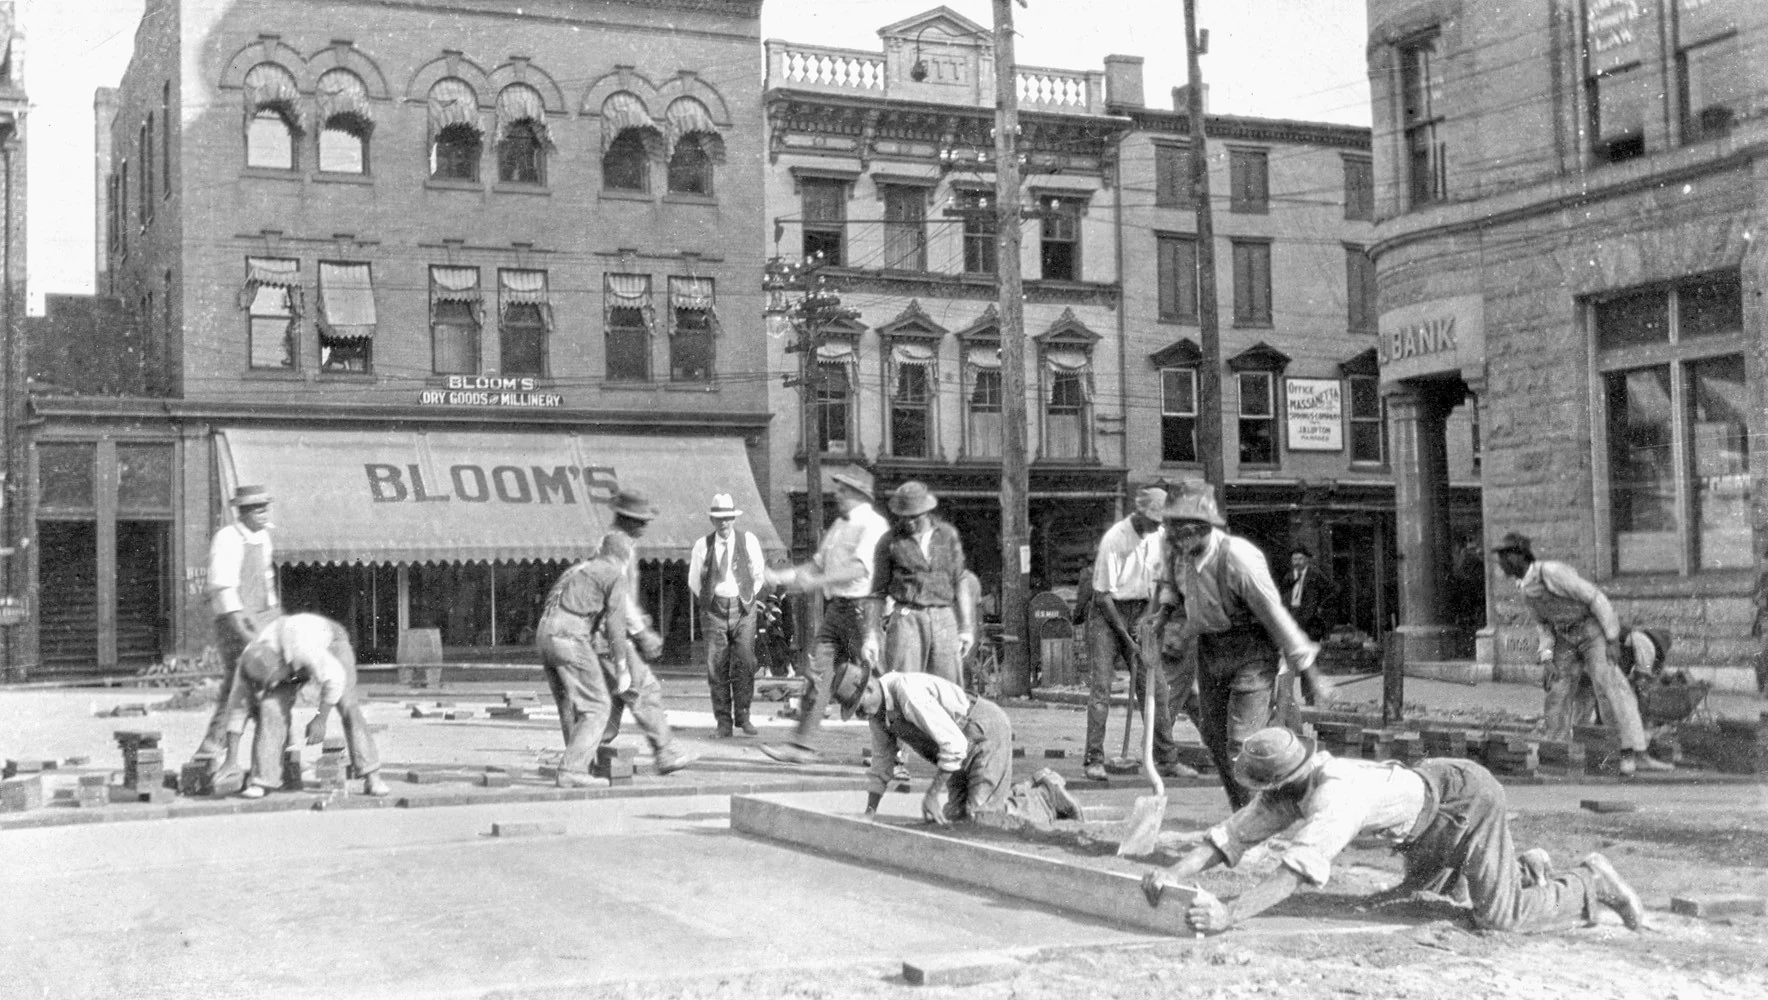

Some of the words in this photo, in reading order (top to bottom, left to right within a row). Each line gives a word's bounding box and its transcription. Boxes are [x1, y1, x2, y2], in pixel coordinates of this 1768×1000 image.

[1391, 317, 1456, 360] BANK
[449, 376, 534, 390] BLOOM'S
[423, 392, 446, 404] DRY
[450, 391, 488, 405] GOODS
[501, 393, 560, 407] MILLINERY
[364, 463, 619, 505] BLOOM'S
